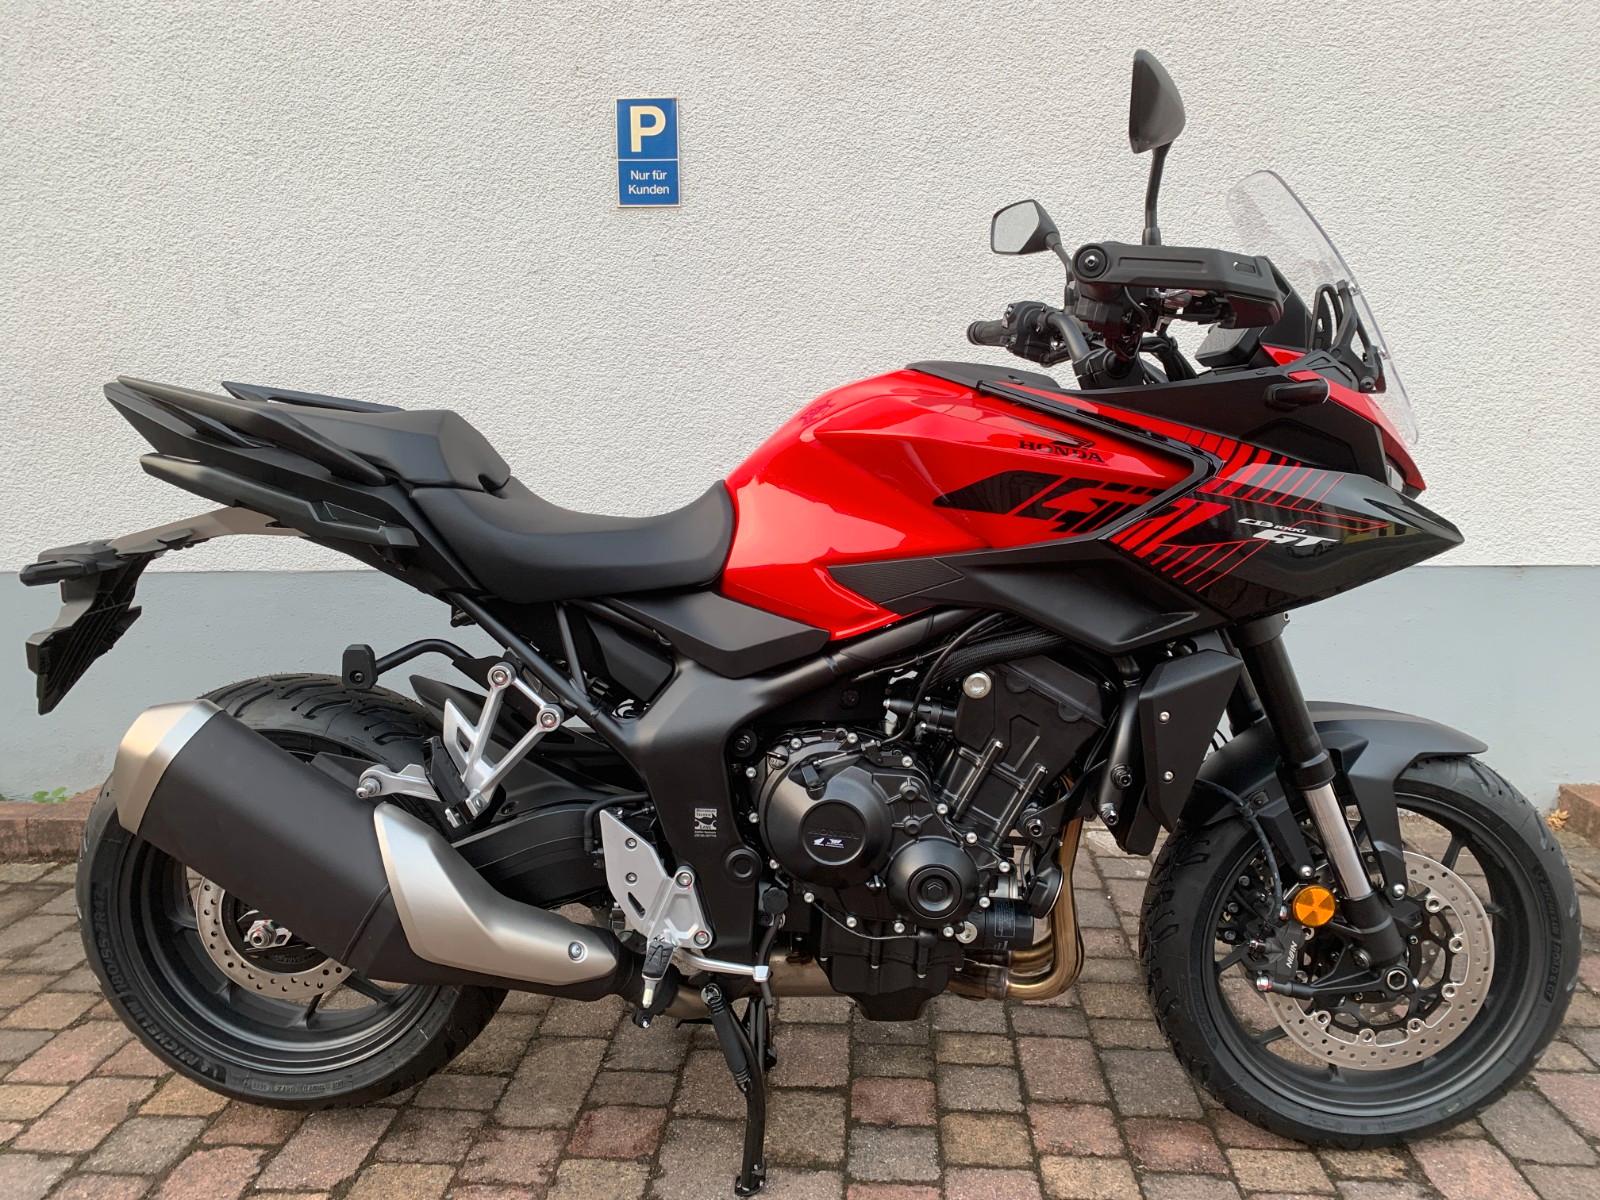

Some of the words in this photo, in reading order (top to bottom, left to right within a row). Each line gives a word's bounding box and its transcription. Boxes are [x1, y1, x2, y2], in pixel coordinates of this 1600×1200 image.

[629, 105, 667, 153] P
[630, 170, 650, 180] Nur
[652, 169, 667, 180] für
[628, 184, 670, 195] Kunden
[1019, 440, 1106, 464] HONDA
[126, 997, 200, 1067] MICHELIN
